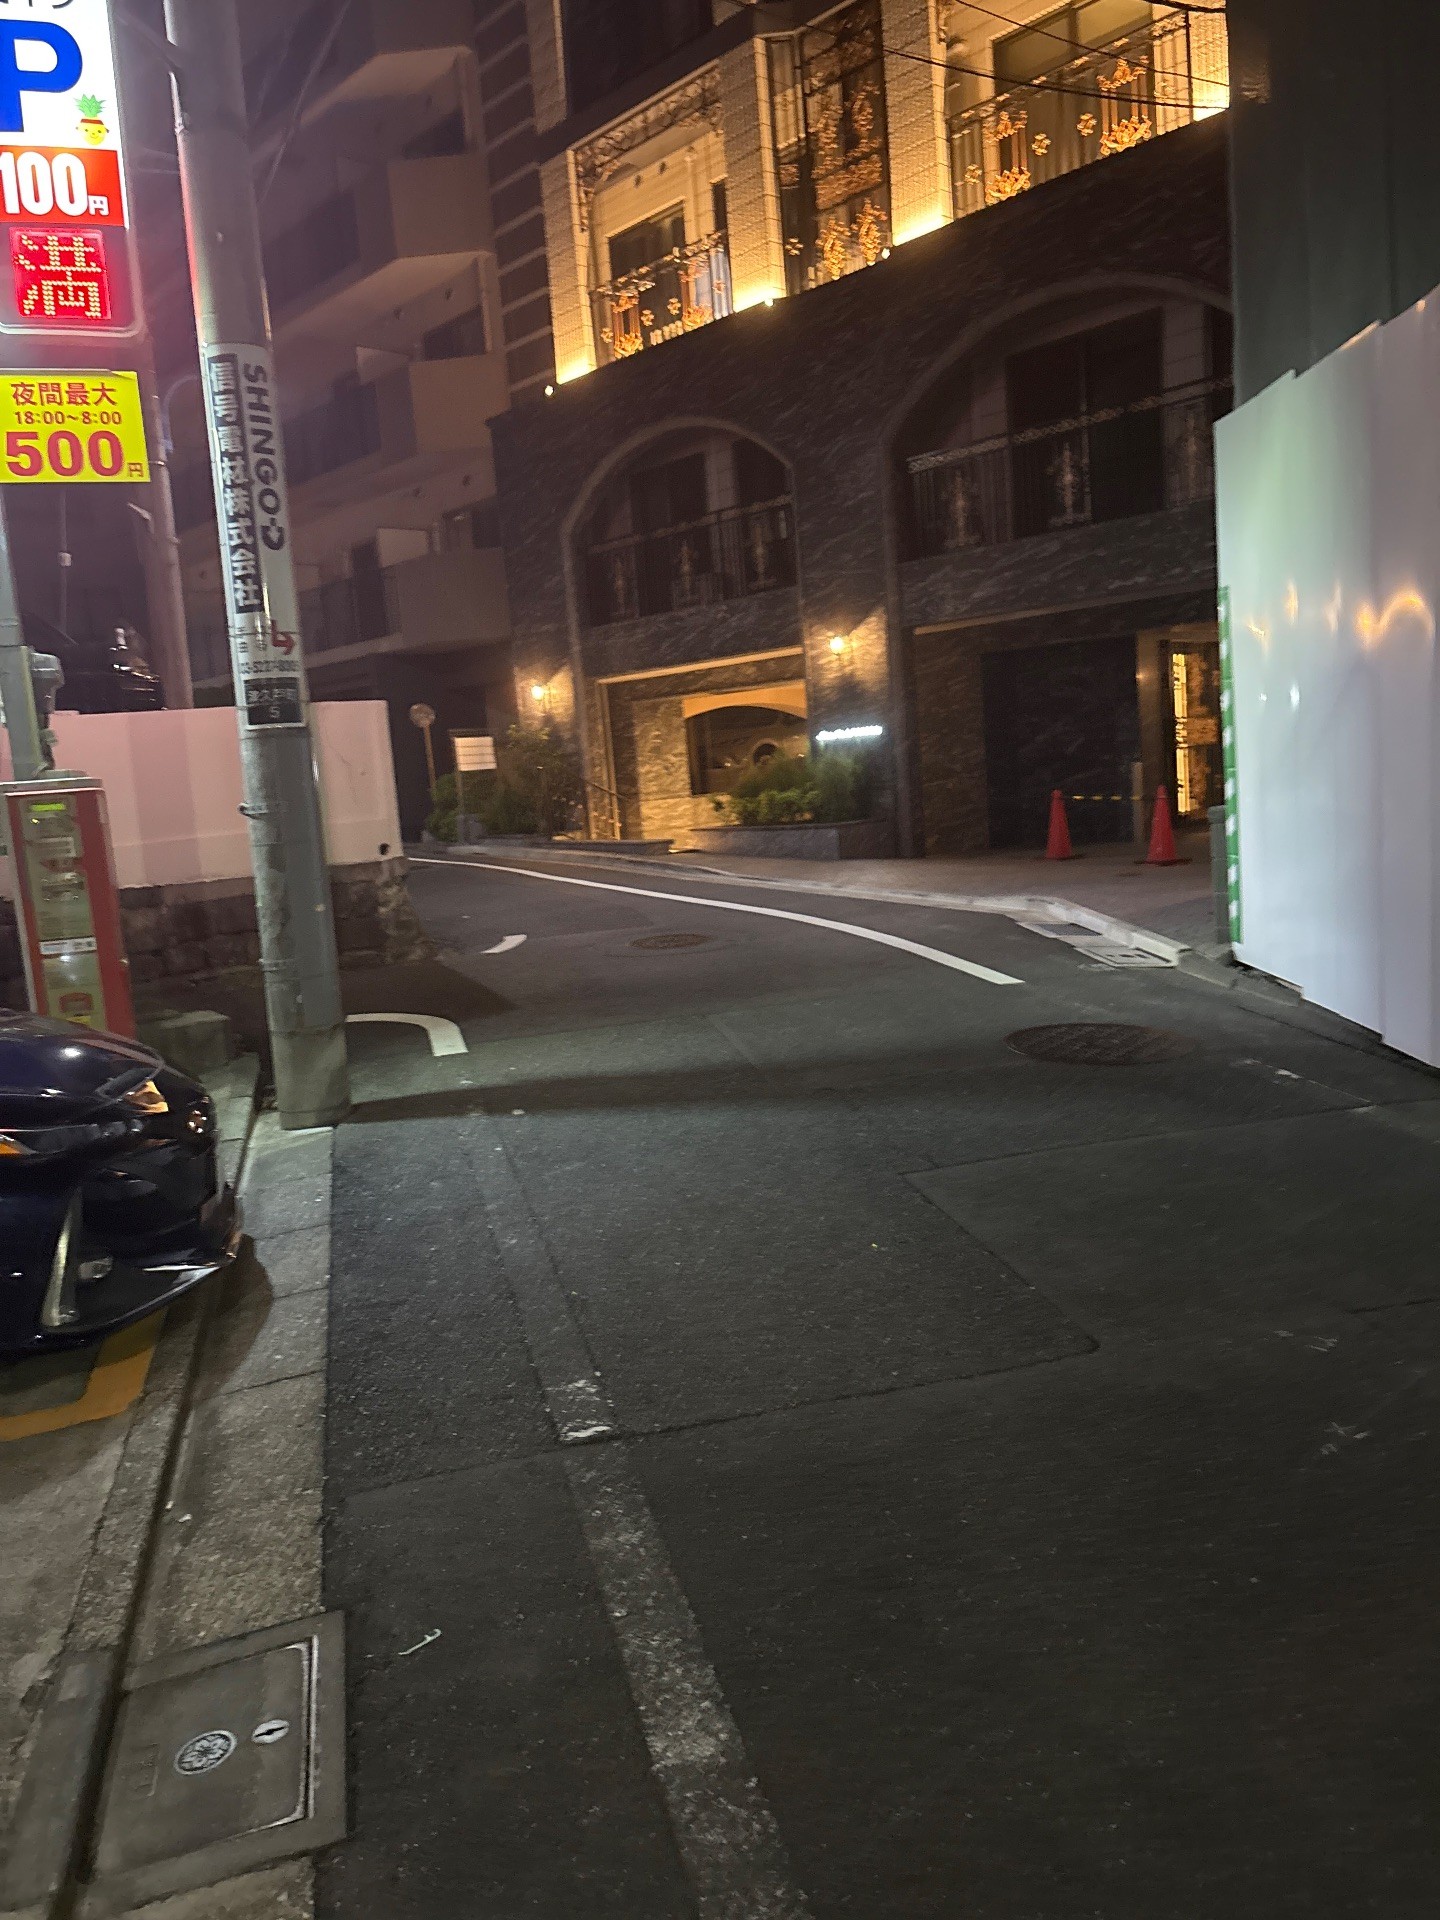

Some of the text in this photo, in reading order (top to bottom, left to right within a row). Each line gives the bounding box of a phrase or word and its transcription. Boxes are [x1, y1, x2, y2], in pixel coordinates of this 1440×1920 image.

[0, 18, 82, 132] P
[15, 234, 102, 317] 満
[11, 382, 118, 406] 夜間最大
